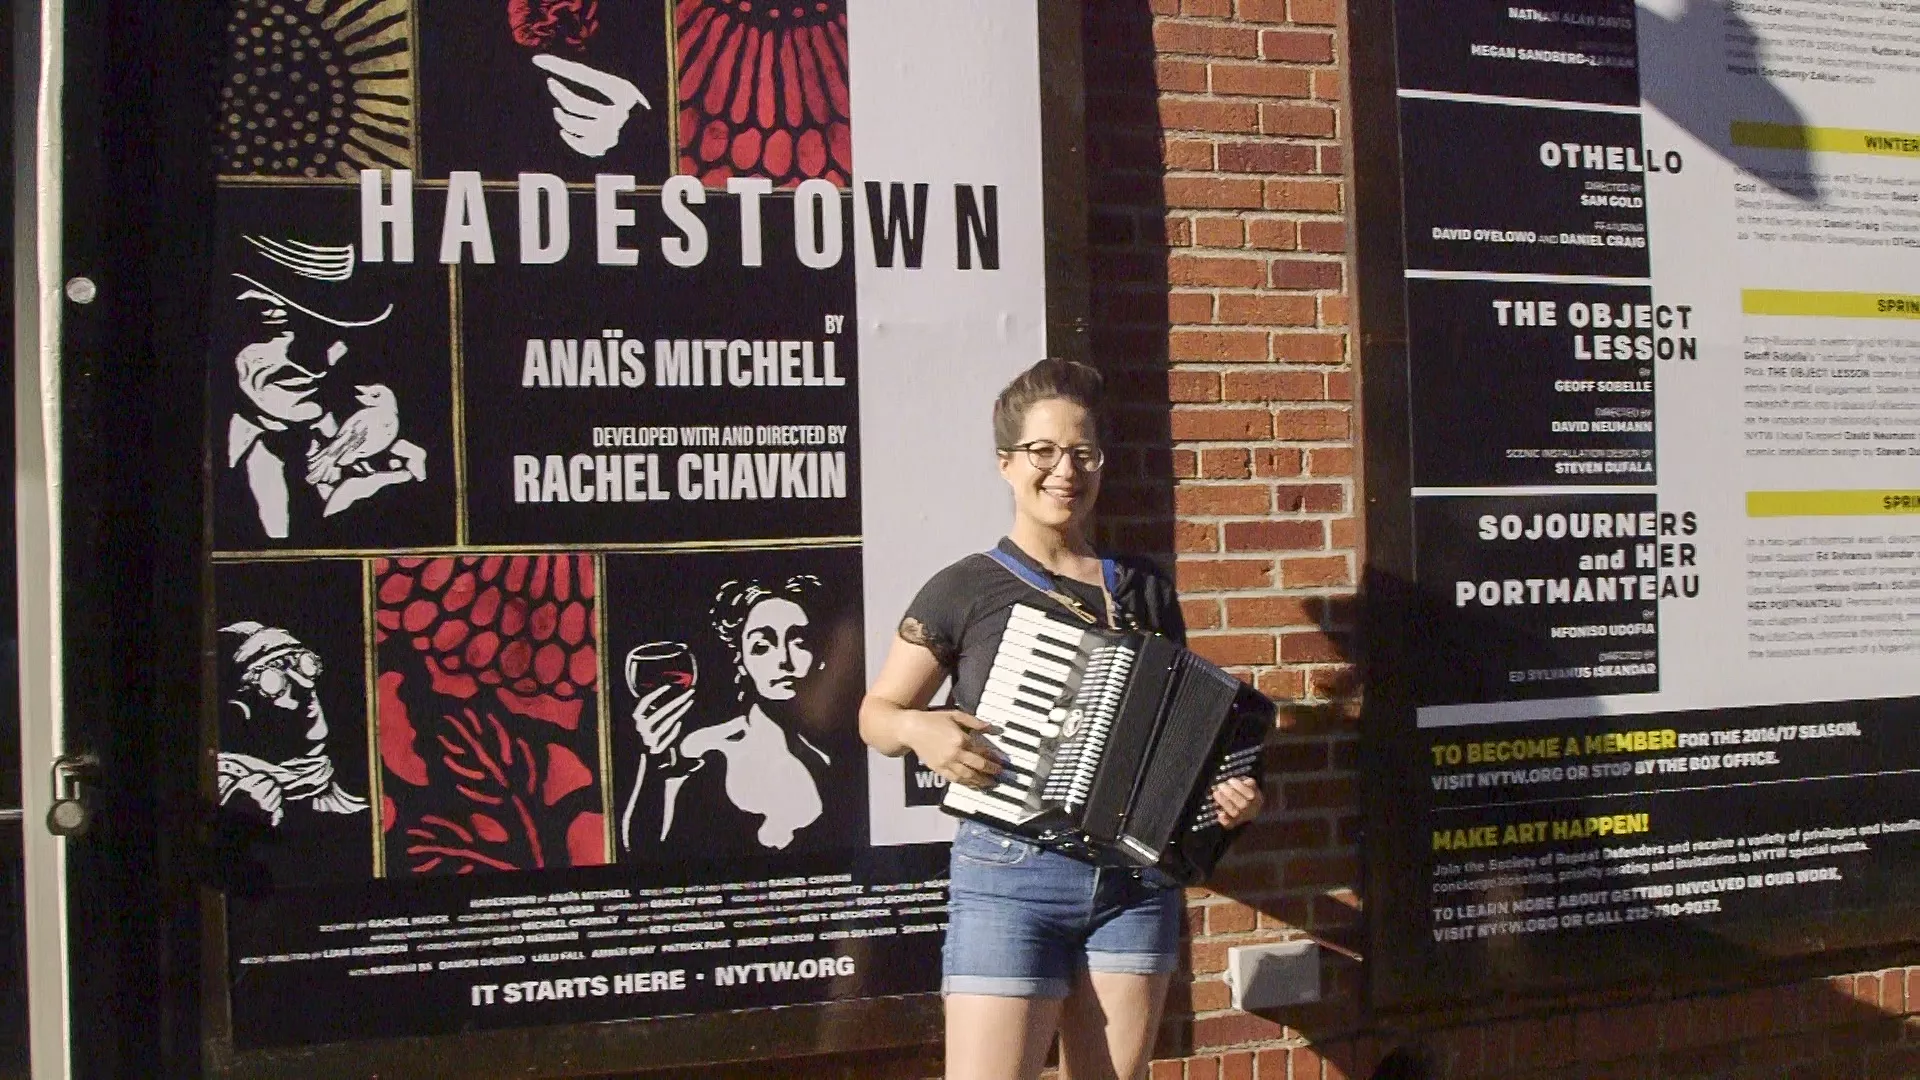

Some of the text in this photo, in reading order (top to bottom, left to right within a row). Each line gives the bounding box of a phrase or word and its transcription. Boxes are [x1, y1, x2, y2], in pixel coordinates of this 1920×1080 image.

[1471, 43, 1516, 58] MEGAN
[1539, 141, 1683, 174] OTHELLO
[1580, 194, 1643, 208] SAM GOLD
[360, 169, 1000, 270] HADESTOWN
[1432, 227, 1472, 241] DAVID
[1473, 229, 1537, 243] OYELOWO
[1559, 233, 1606, 246] DANIEL
[1607, 235, 1646, 248] CRAIG
[825, 315, 844, 334] BY
[1492, 301, 1692, 329] THE OBJECT
[522, 328, 846, 388] ANAÏS MITCHELL
[1574, 334, 1697, 360] LESSON
[1554, 379, 1653, 392] GEOFF SOBELLE
[592, 425, 847, 447] DEVELOPED WITH AND DIRECTED BY
[1551, 421, 1653, 432] DAVID NEUMANN
[514, 451, 847, 503] RACHEL CHAVKIN
[1555, 462, 1603, 474] STEVEN
[1478, 511, 1698, 541] SOJOURNERS
[1578, 543, 1697, 570] and HER
[1456, 574, 1699, 608] PORTMANTEAU
[1609, 622, 1656, 636] UDOFIA
[1509, 670, 1526, 682] ED
[1592, 663, 1656, 678] ISKANDAR
[1431, 744, 1462, 766] TO
[1467, 737, 1560, 764] BECOME
[1564, 737, 1581, 756] A
[1583, 729, 1677, 755] MEMBER
[1678, 732, 1710, 748] FOR
[1711, 729, 1741, 745] THE
[1431, 773, 1475, 791] VISIT
[1476, 766, 1563, 788] NYTW.ORG
[1565, 765, 1590, 780] OR
[1590, 761, 1633, 778] STOP
[1634, 759, 1656, 775] BY
[1657, 757, 1688, 773] THE
[1689, 755, 1721, 770] BOX
[1432, 813, 1650, 851] MAKE ART HAPPEN!
[1432, 907, 1454, 923] TO
[1457, 901, 1510, 919] LEARN
[1512, 896, 1555, 915] MORE
[1558, 890, 1609, 909] ABOUT
[1610, 884, 1674, 903] GETTING
[1675, 876, 1746, 897] INVOLVED
[1764, 870, 1795, 887] OUR
[1432, 925, 1475, 943] VISIT
[1560, 913, 1583, 929] OR
[1584, 909, 1624, 926] CALL
[471, 955, 855, 1006] IT STARTS HERE NYTW.ORG
